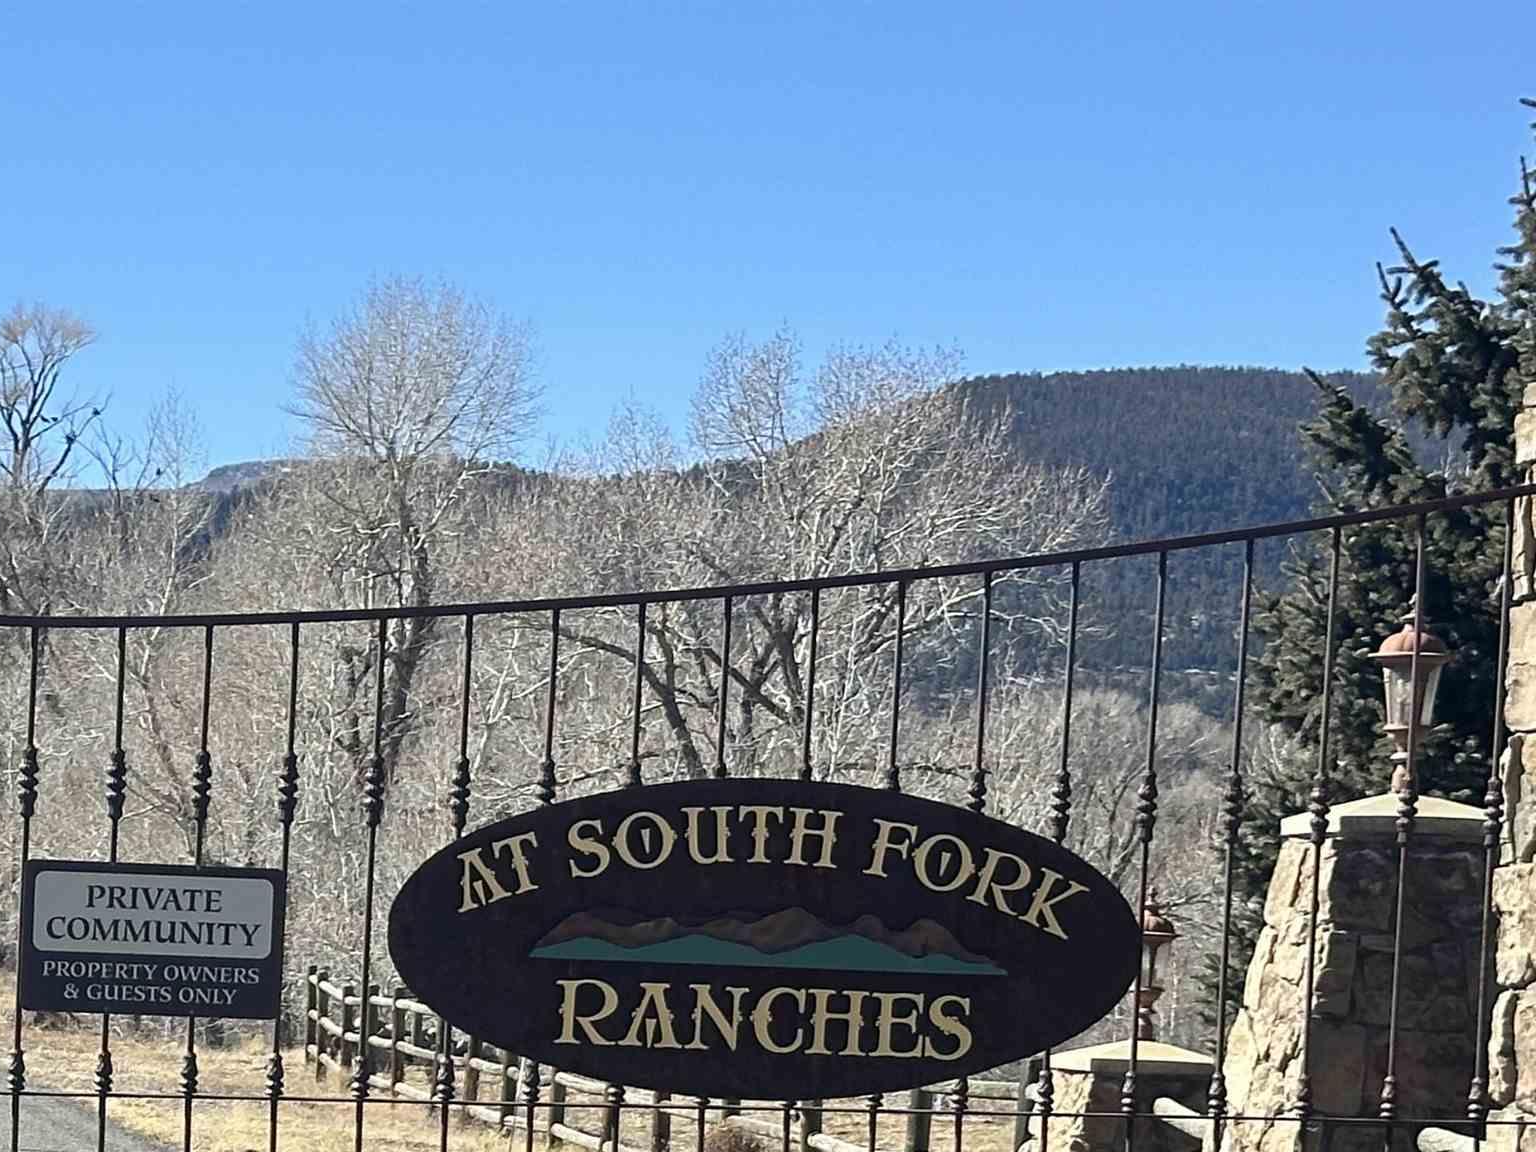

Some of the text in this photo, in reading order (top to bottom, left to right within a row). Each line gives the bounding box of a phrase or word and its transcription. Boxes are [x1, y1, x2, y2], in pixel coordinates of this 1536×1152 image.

[456, 805, 1090, 941] AT SOUTH FORK
[86, 884, 223, 913] PRIVATE
[46, 916, 262, 947] COMMUNITY
[42, 960, 260, 985] PROPERTY OWNERS
[63, 983, 237, 1005] & GUESTS ONLY
[554, 978, 973, 1061] RANCHES
